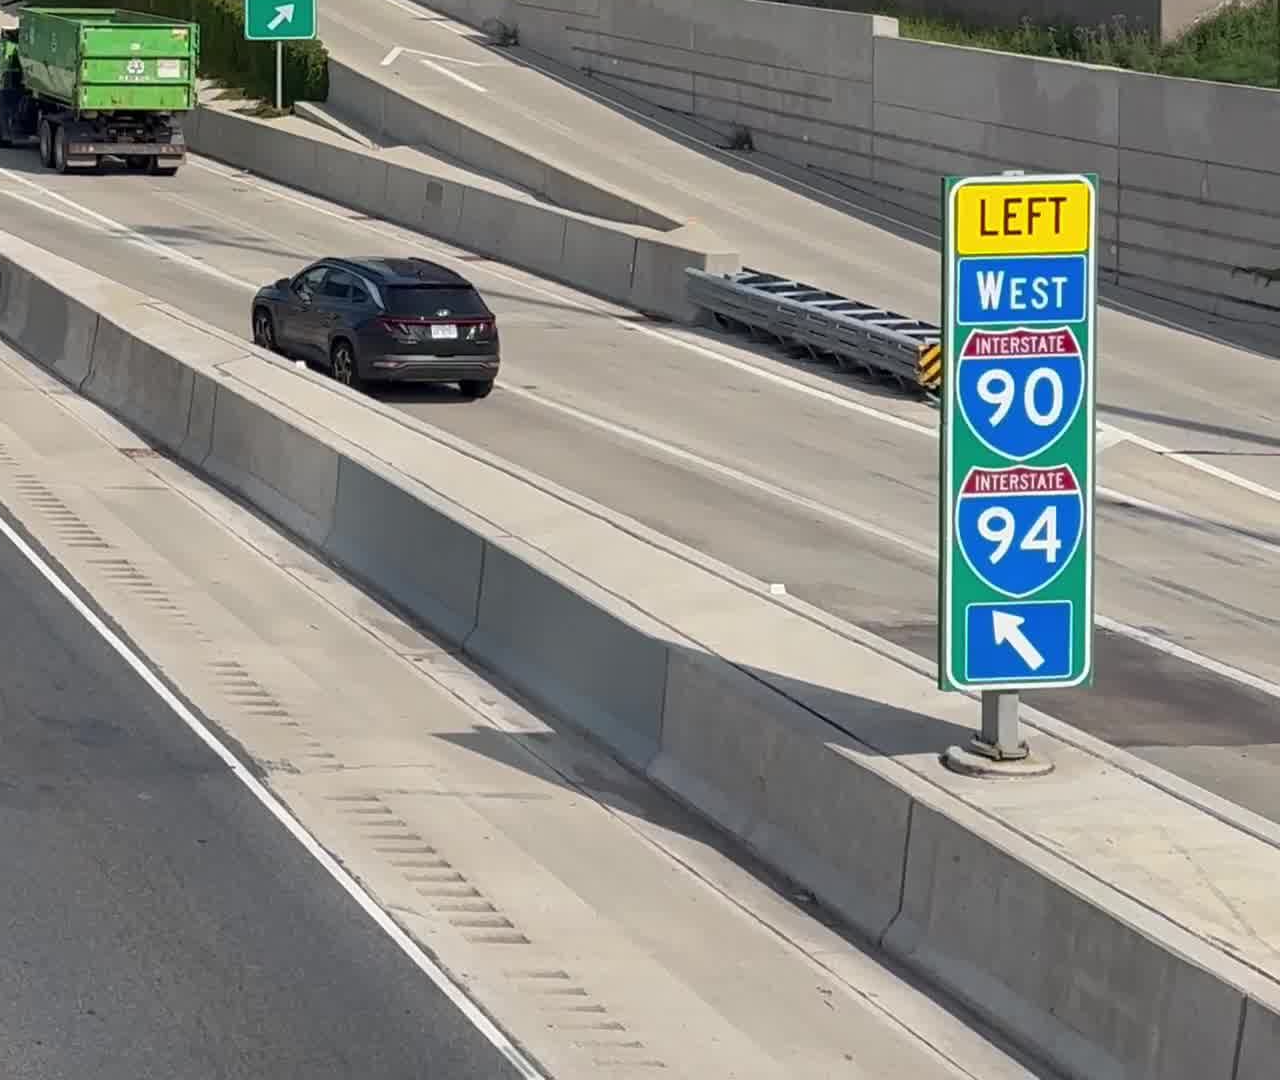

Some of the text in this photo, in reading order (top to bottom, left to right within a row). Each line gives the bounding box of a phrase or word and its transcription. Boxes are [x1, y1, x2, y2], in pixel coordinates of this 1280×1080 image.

[980, 196, 1068, 236] LEFT
[976, 270, 1069, 311] WEST
[975, 335, 1066, 355] INTERSTATE
[976, 367, 1064, 427] 90
[975, 471, 1065, 491] INTERSTATE
[977, 505, 1062, 565] 94
